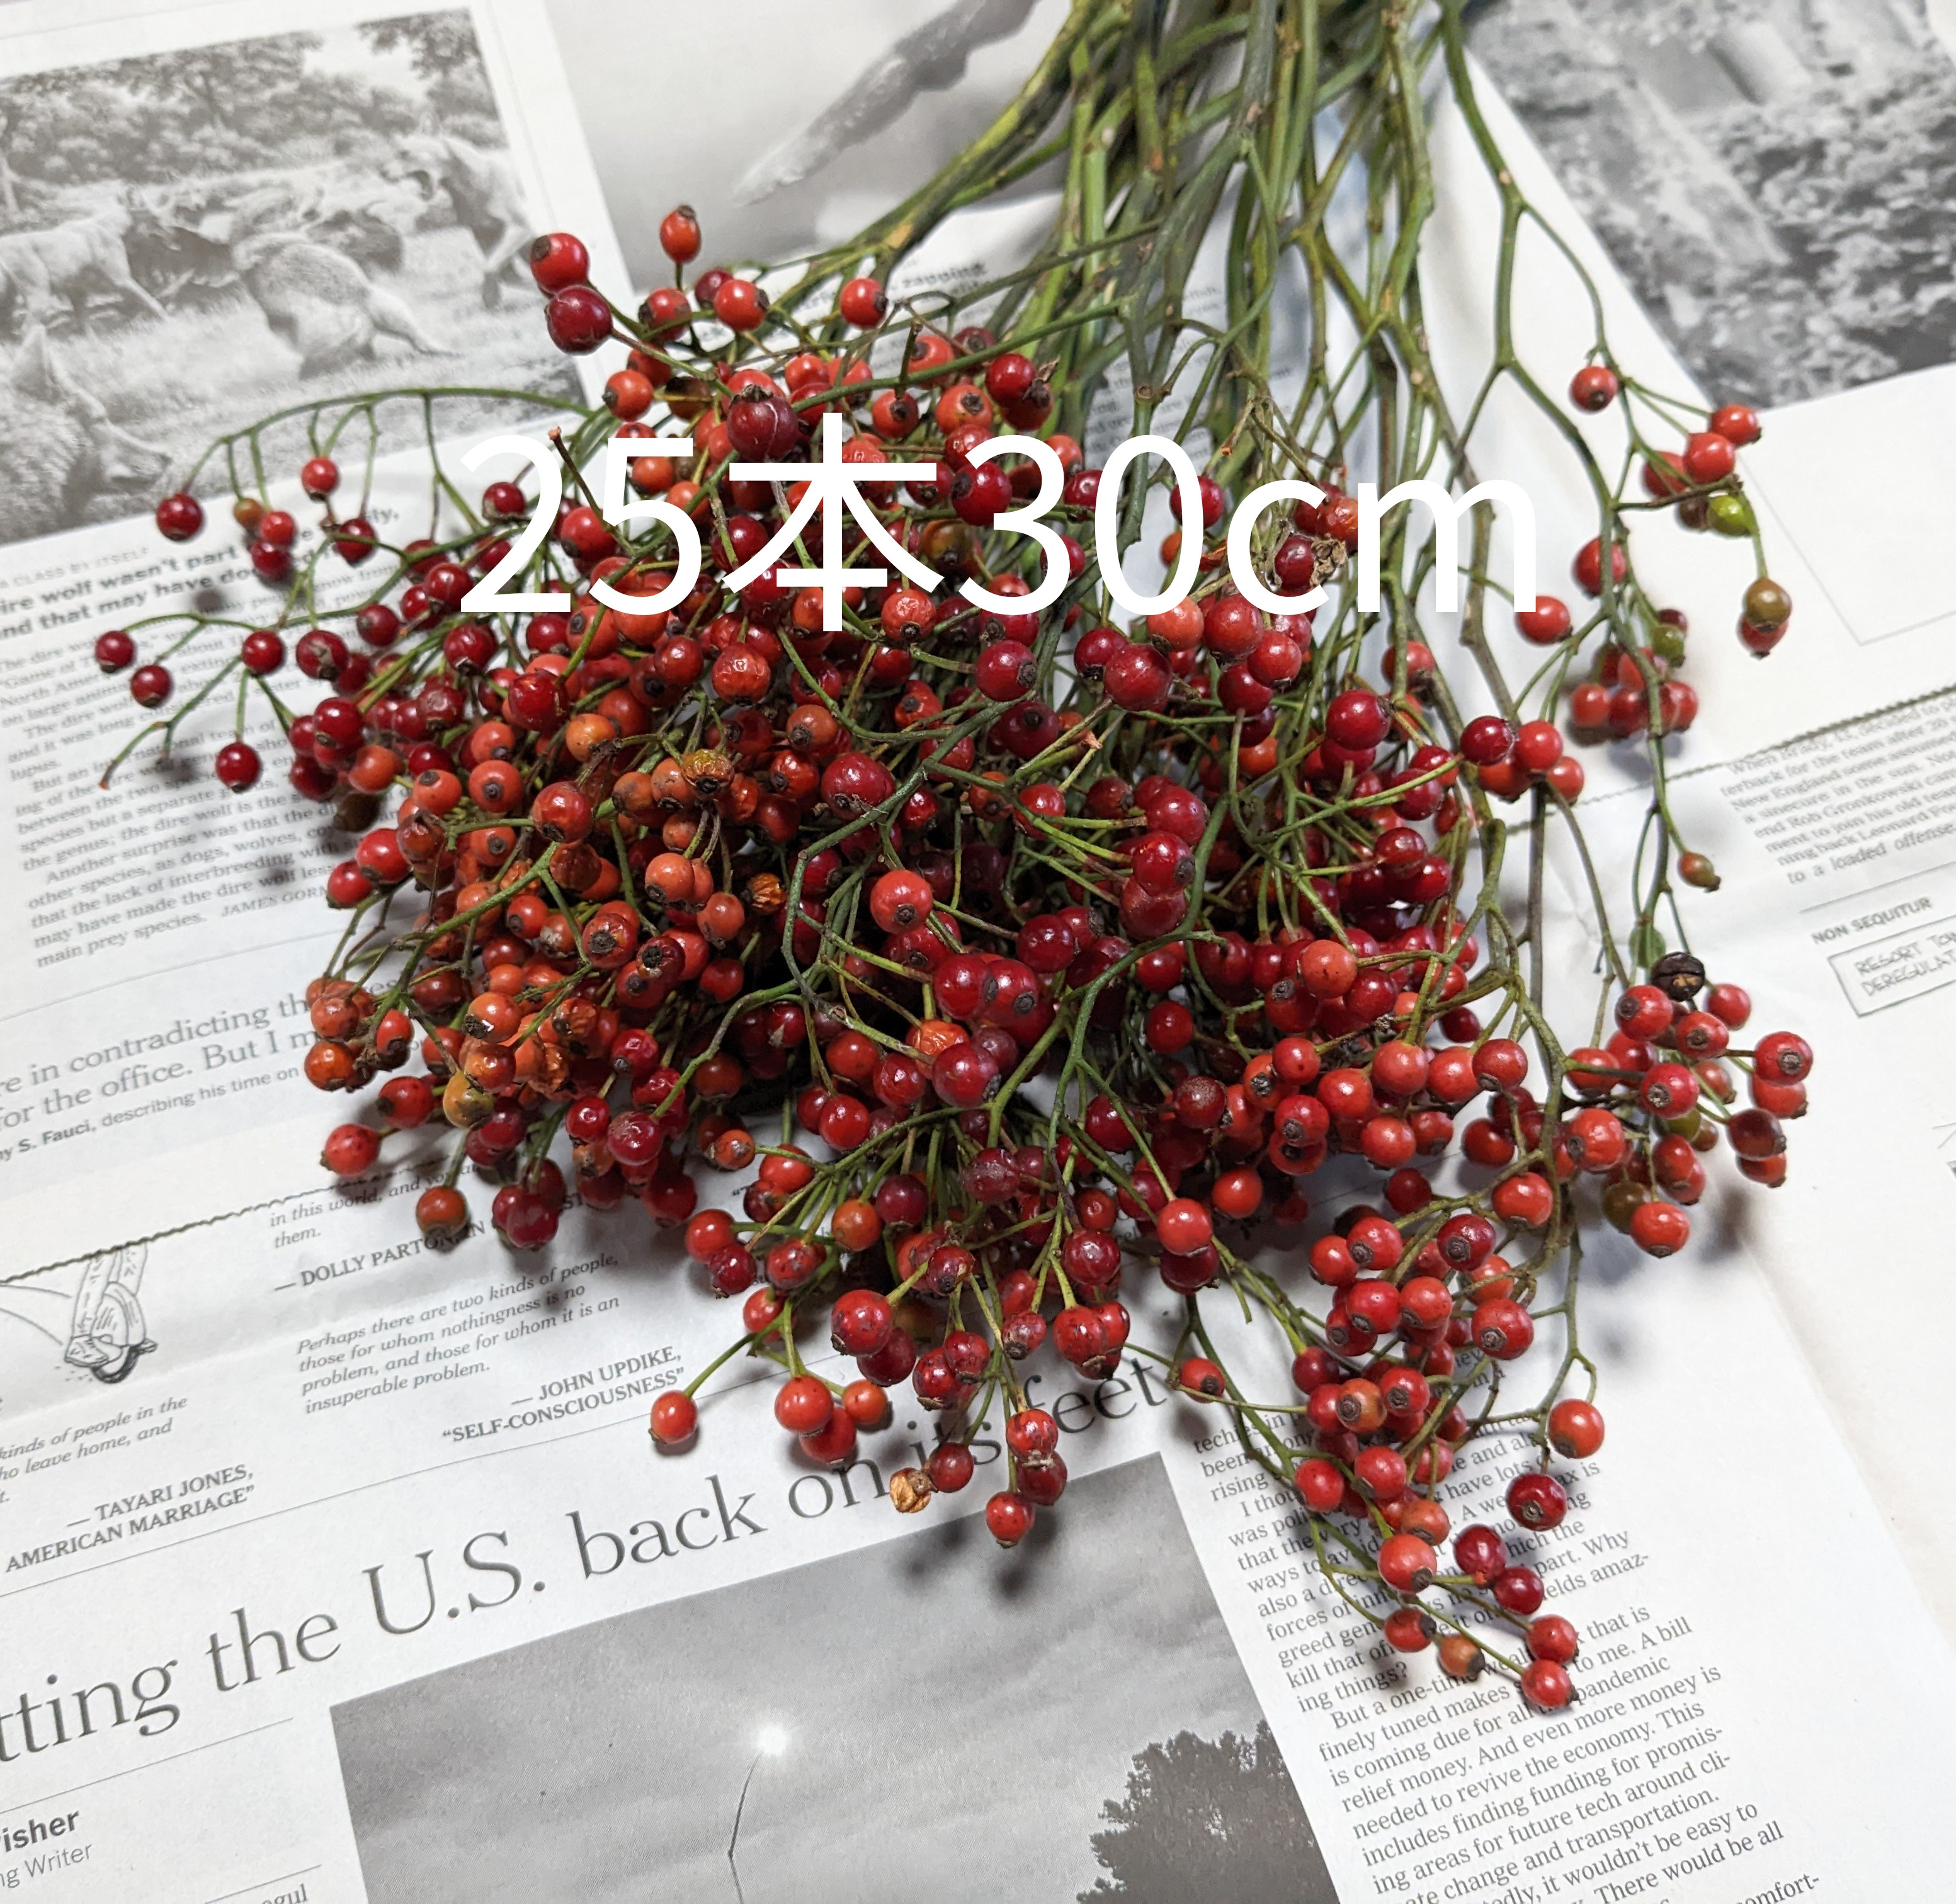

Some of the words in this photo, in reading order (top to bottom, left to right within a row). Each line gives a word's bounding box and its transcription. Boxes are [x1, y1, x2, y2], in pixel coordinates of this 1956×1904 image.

[39, 605, 91, 628] that
[99, 590, 147, 614] may
[155, 575, 213, 596] have
[40, 581, 91, 603] wolf
[187, 547, 239, 572] part
[137, 790, 214, 815] separate
[47, 854, 115, 885] Another
[122, 833, 196, 860] surprise
[242, 814, 279, 830] that
[285, 807, 313, 822] the
[29, 885, 74, 908] other
[31, 910, 67, 928] that
[72, 898, 100, 915] the
[105, 886, 142, 905] lack
[147, 879, 165, 892] of
[171, 853, 293, 888] interbreeding
[34, 927, 71, 948] may
[77, 913, 121, 934] have
[126, 897, 177, 919] made
[182, 889, 212, 905] the
[217, 878, 253, 898] dire
[259, 870, 296, 886] wolf
[37, 947, 82, 968] main
[88, 932, 128, 955] prey
[222, 895, 278, 917] JAMES
[1811, 925, 1849, 944] NON
[1851, 896, 1932, 932] SEQUITUR
[1855, 943, 1921, 974] RESORT
[31, 1063, 59, 1085] in
[69, 1006, 270, 1075] contradicting
[45, 1088, 93, 1114] the
[101, 1063, 193, 1098] office.
[202, 1041, 259, 1070] But
[268, 1030, 281, 1054] I
[18, 1138, 37, 1153] S.
[42, 1119, 96, 1145] Fauci,
[103, 1092, 196, 1127] describing
[199, 1085, 227, 1101] his
[232, 1072, 271, 1091] time
[277, 1065, 299, 1082] on
[270, 1213, 287, 1227] in
[292, 1202, 323, 1221] this
[389, 1178, 421, 1198] and
[275, 1229, 321, 1249] them.
[300, 1255, 366, 1287] DOLLY
[297, 1327, 367, 1354] Perhaps
[372, 1315, 415, 1334] there
[421, 1306, 448, 1321] are
[453, 1294, 484, 1312] two
[490, 1277, 535, 1301] kinds
[539, 1266, 557, 1284] of
[561, 1254, 618, 1283] people,
[299, 1354, 346, 1373] those
[351, 1344, 375, 1361] for
[381, 1331, 435, 1352] whom
[441, 1296, 541, 1338] nothingness
[547, 1291, 559, 1306] is
[564, 1284, 586, 1300] no
[302, 1363, 378, 1397] problem,
[386, 1351, 420, 1370] and
[426, 1341, 472, 1362] those
[475, 1332, 500, 1351] for
[504, 1318, 557, 1341] whom
[563, 1309, 576, 1323] it
[579, 1303, 593, 1318] is
[598, 1296, 620, 1312] an
[538, 1372, 594, 1401] JOHN
[598, 1346, 682, 1381] UPDIKE,
[305, 1375, 408, 1415] insuperable
[412, 1361, 490, 1390] problem.
[443, 1366, 685, 1442] “SELF-CONSCIOUSNESS”
[25, 1450, 72, 1475] leave
[77, 1434, 132, 1459] home,
[137, 1417, 174, 1441] and
[50, 1427, 72, 1446] of
[74, 1414, 132, 1442] people
[137, 1406, 154, 1420] in
[160, 1396, 188, 1413] the
[94, 1485, 173, 1521] TAYARI
[179, 1463, 254, 1497] JONES,
[1210, 1471, 1268, 1501] rising
[6, 1524, 123, 1573] AMERICAN
[129, 1484, 255, 1536] MARRIAGE”
[205, 1606, 342, 1694] the
[363, 1531, 546, 1635] U.S.
[566, 1473, 768, 1579] back
[788, 1456, 890, 1519] on
[907, 1419, 1003, 1476] is
[1229, 1523, 1268, 1548] was
[1237, 1546, 1279, 1571] that
[1248, 1565, 1299, 1594] ways
[1258, 1594, 1298, 1617] also
[1583, 1530, 1630, 1556] Why
[1267, 1609, 1329, 1641] forces
[1279, 1636, 1337, 1668] greed
[1586, 1614, 1629, 1639] that
[1286, 1663, 1321, 1689] kill
[1324, 1650, 1362, 1675] that
[1657, 1616, 1693, 1641] bill
[1297, 1692, 1334, 1714] ing
[1334, 1660, 1407, 1701] things?
[1574, 1656, 1671, 1704] pandemic
[1330, 1705, 1370, 1729] But
[1630, 1675, 1697, 1711] money
[1319, 1730, 1377, 1762] finely
[1381, 1711, 1441, 1741] tuned
[1444, 1686, 1510, 1718] makes
[1656, 1699, 1705, 1729] This
[1354, 1742, 1431, 1779] coming
[1433, 1726, 1471, 1750] due
[1473, 1716, 1503, 1737] for
[1342, 1779, 1396, 1813] relief
[1399, 1757, 1472, 1792] money.
[1478, 1737, 1520, 1765] And
[1523, 1721, 1572, 1748] even
[1574, 1703, 1627, 1731] more
[1646, 1726, 1722, 1768] promis-
[1352, 1798, 1428, 1839] needed
[1457, 1767, 1523, 1803] revive
[1525, 1754, 1560, 1776] the
[1564, 1721, 1656, 1765] economy.
[0, 1810, 80, 1854] isher
[1362, 1824, 1450, 1866] includes
[1453, 1796, 1529, 1835] finding
[1530, 1766, 1612, 1806] funding
[1612, 1755, 1641, 1776] for
[1372, 1871, 1411, 1895] ing
[1413, 1847, 1471, 1880] areas
[1473, 1837, 1504, 1859] for
[1508, 1810, 1574, 1845] future
[1576, 1790, 1622, 1820] tech
[1625, 1763, 1697, 1803] around
[1653, 1832, 1683, 1853] be
[1686, 1811, 1732, 1840] easy
[24, 1842, 93, 1878] Writer
[1444, 1861, 1520, 1900] change
[1523, 1842, 1564, 1871] and
[1566, 1789, 1720, 1854] transportation.
[1662, 1843, 1726, 1882] would
